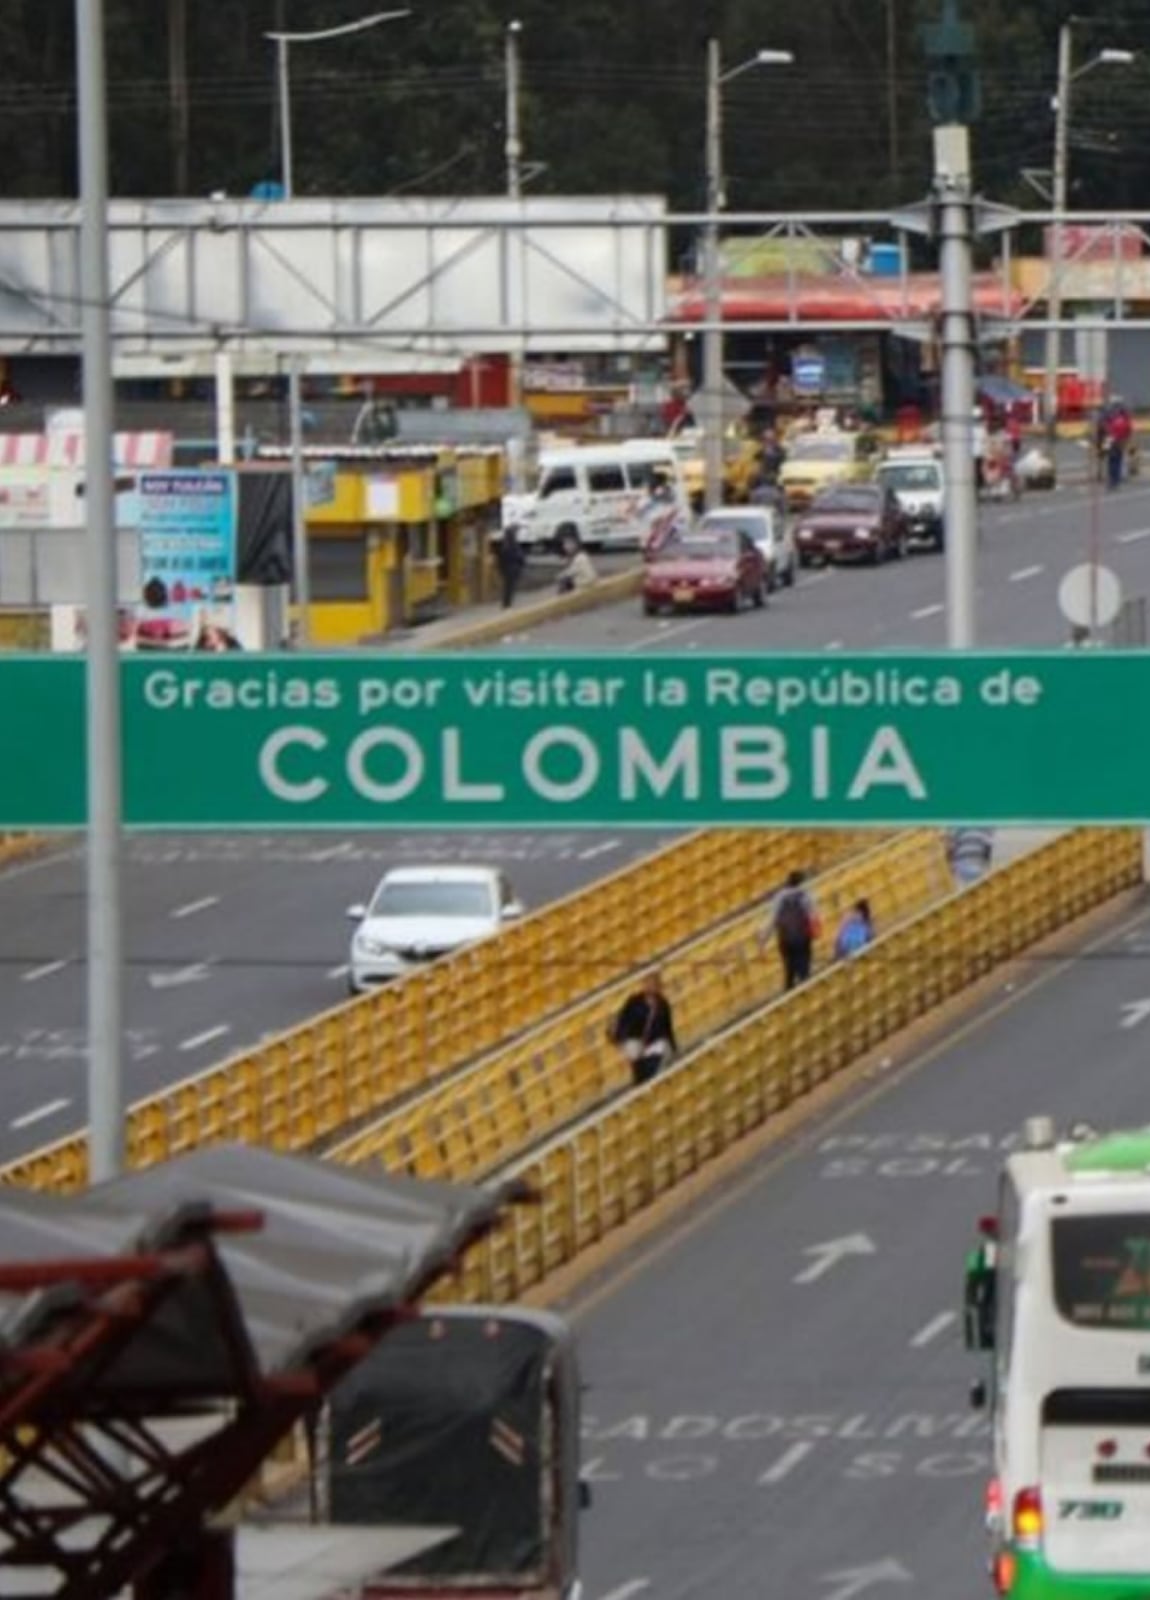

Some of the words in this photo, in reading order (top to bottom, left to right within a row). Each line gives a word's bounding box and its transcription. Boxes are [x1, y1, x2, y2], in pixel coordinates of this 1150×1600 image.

[144, 670, 341, 709] Gracias
[360, 678, 445, 715] por
[463, 670, 625, 708] visitar
[644, 670, 688, 707] la
[706, 668, 963, 716] República
[980, 670, 1043, 706] de
[257, 725, 929, 802] COLOMBIA
